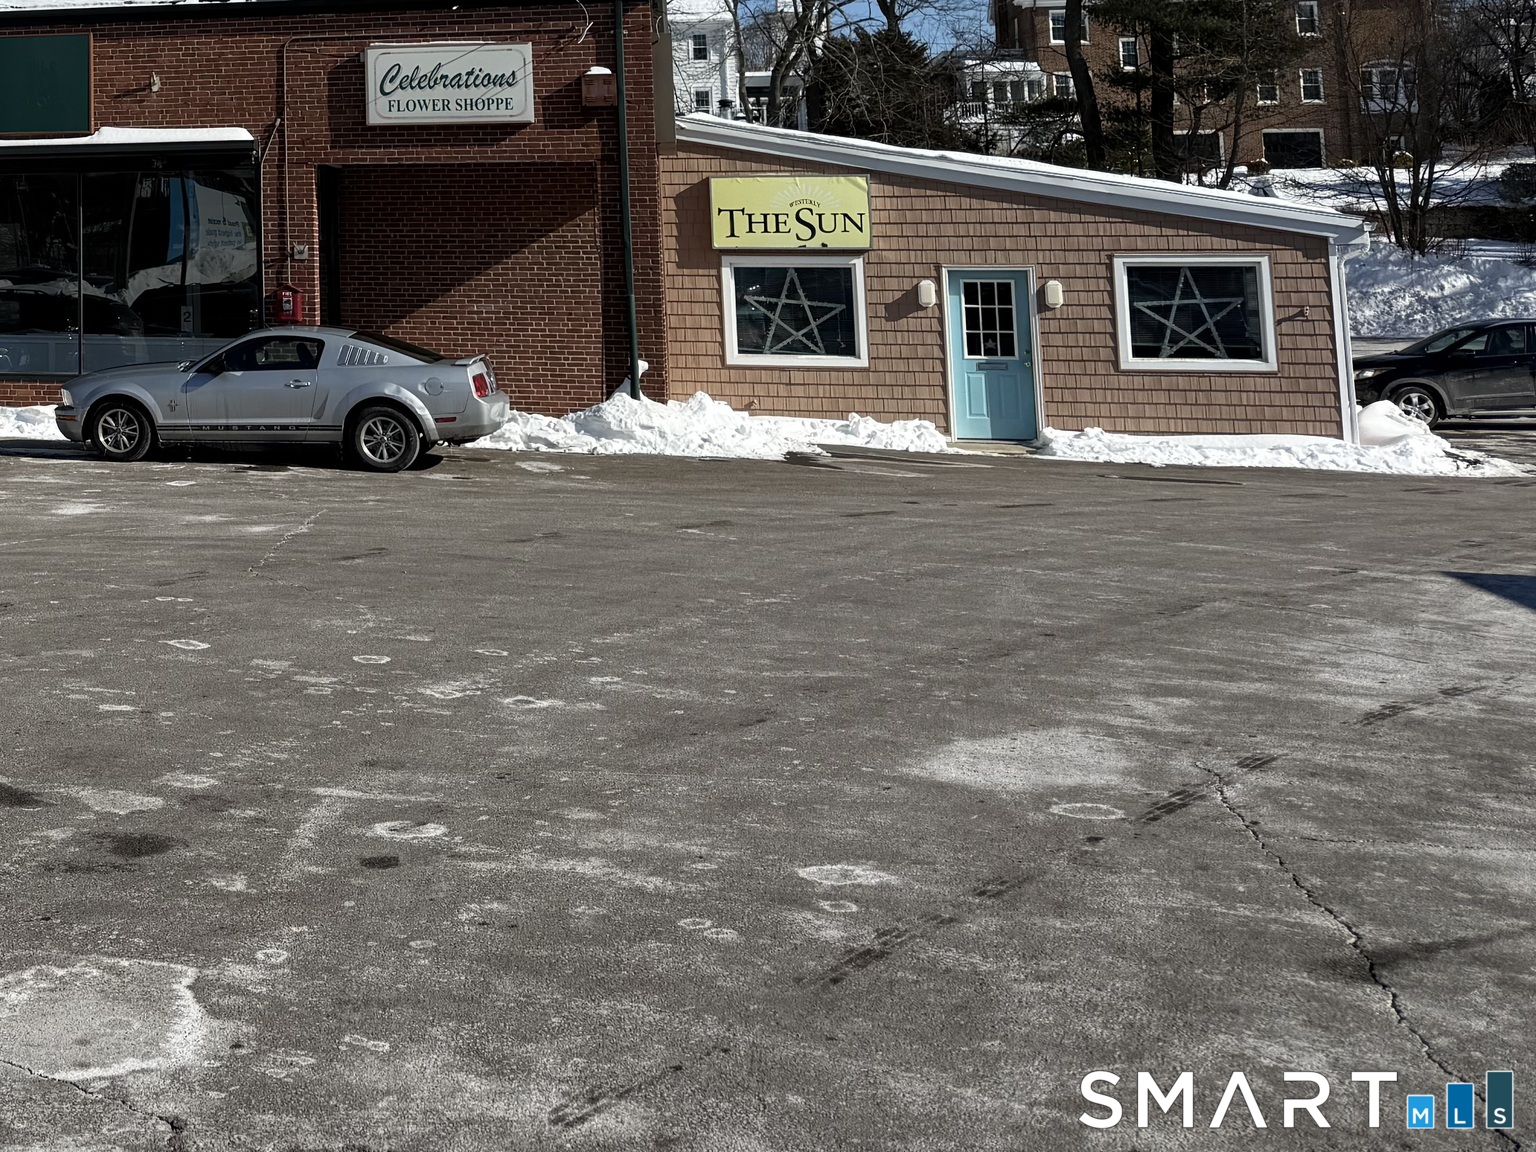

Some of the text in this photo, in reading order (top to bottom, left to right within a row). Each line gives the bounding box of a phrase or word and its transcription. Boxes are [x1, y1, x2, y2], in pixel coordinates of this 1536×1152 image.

[379, 62, 519, 96] Celebrations
[388, 98, 514, 112] FLOWER SHOPPE
[717, 207, 866, 241] THE SUN
[183, 310, 192, 323] 2
